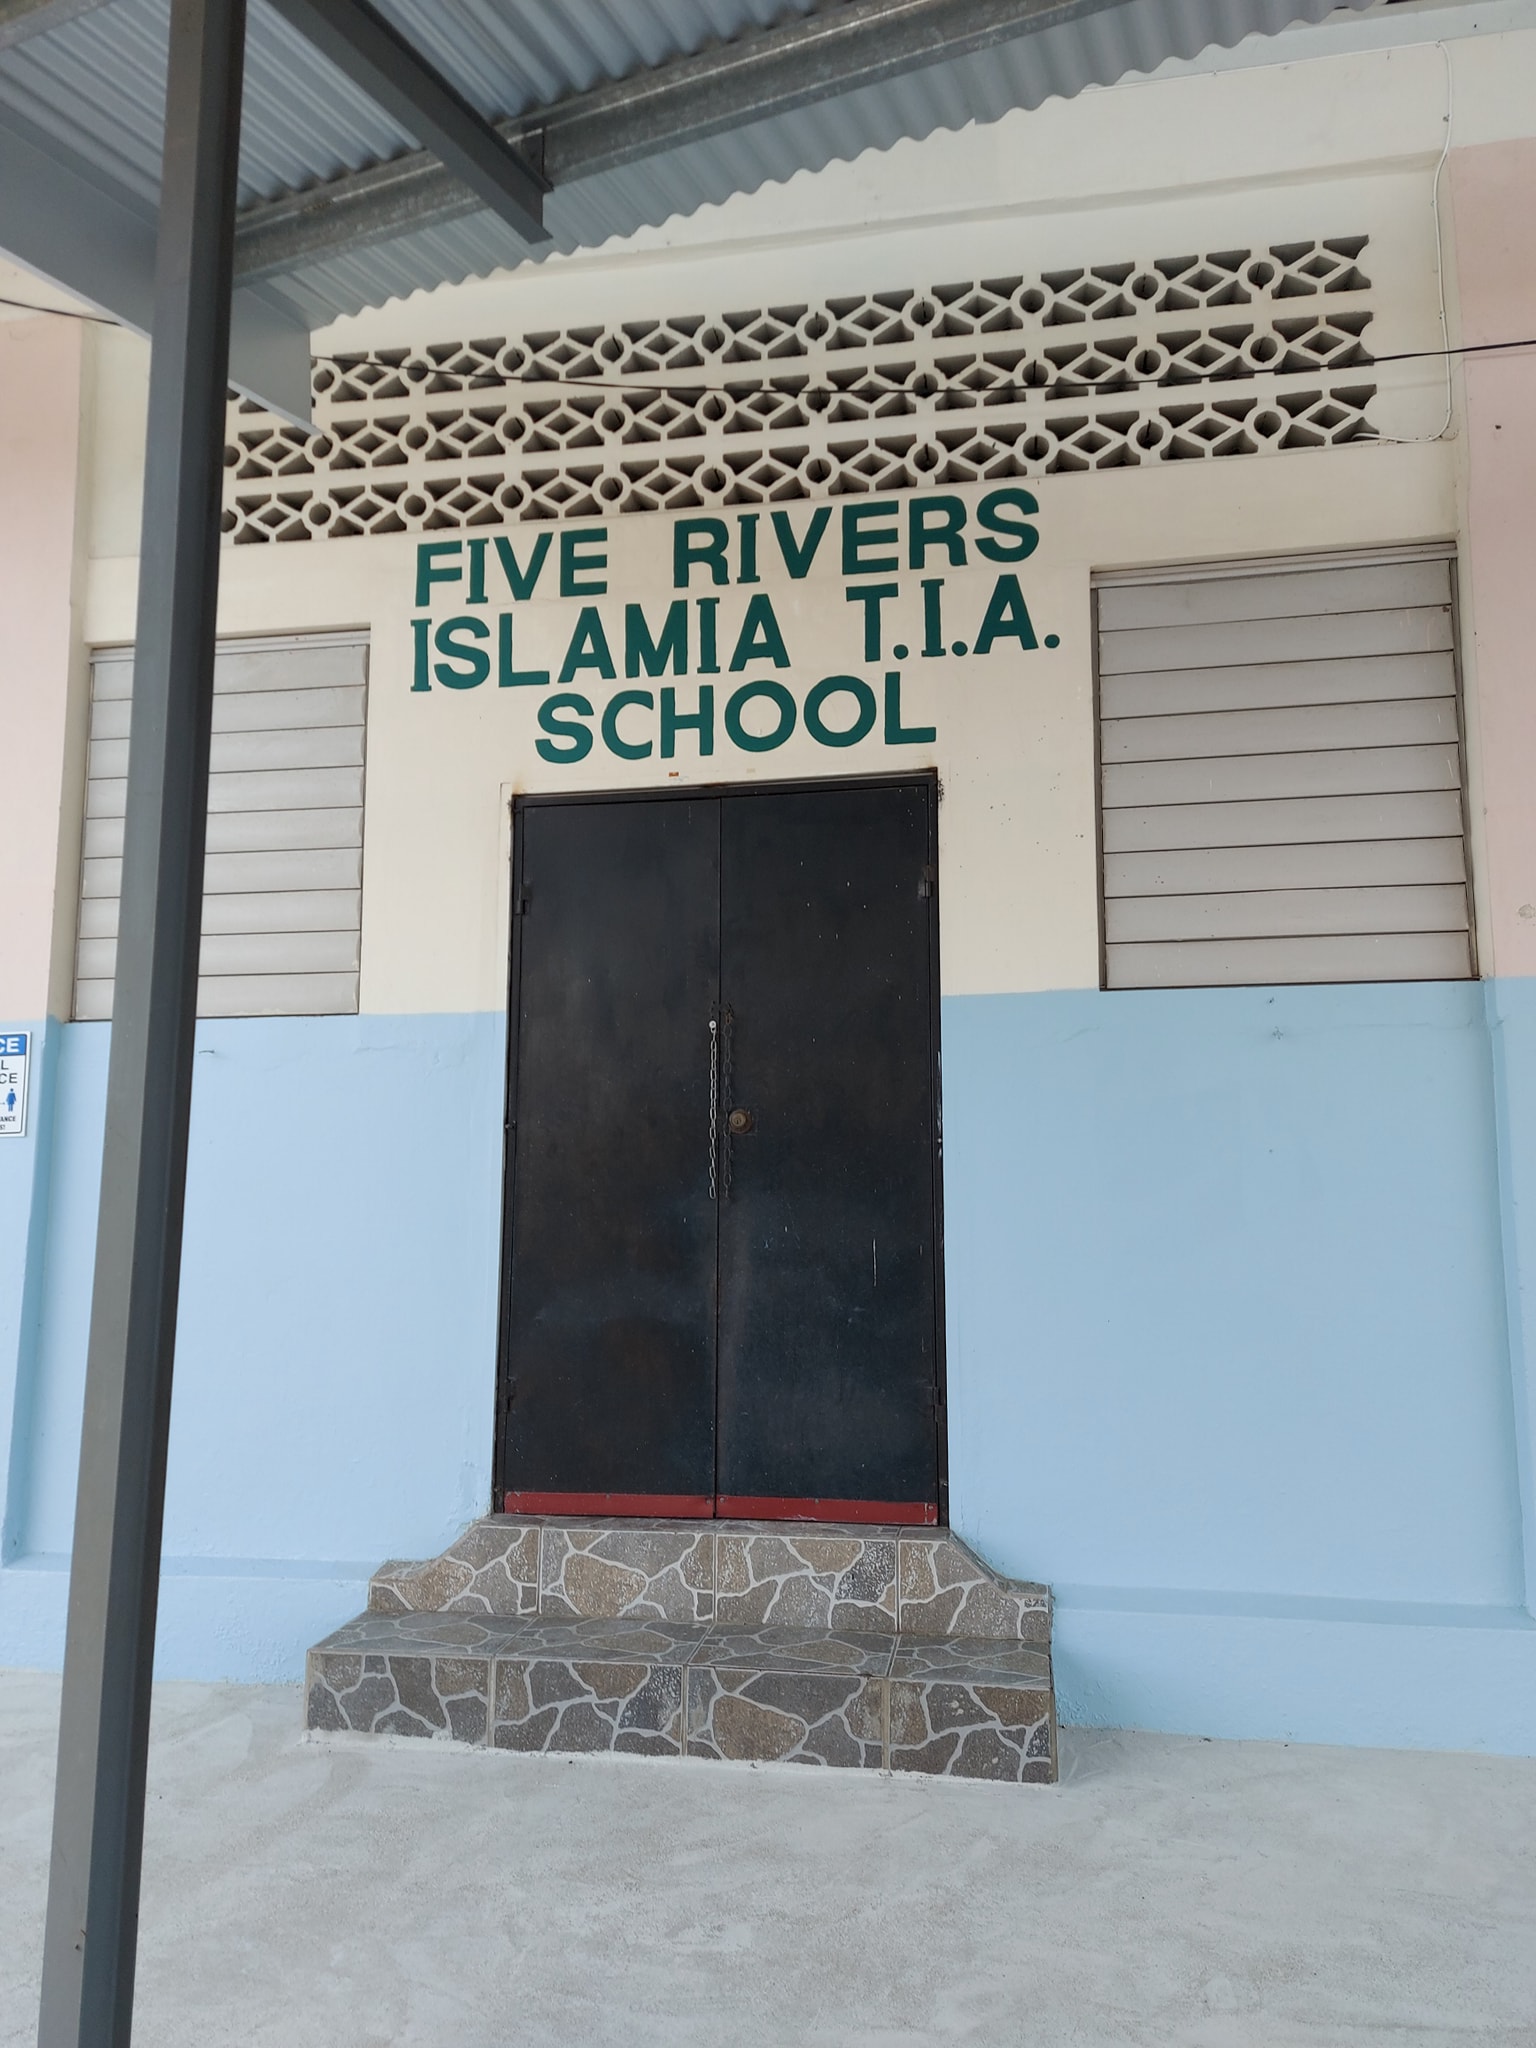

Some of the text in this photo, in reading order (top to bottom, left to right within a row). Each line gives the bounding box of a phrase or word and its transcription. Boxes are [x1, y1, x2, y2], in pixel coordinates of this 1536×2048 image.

[414, 487, 1040, 606] FIVE RIVERS
[410, 573, 1061, 692] ISLAMIA T.I.A.
[534, 671, 937, 764] SCHOOL
